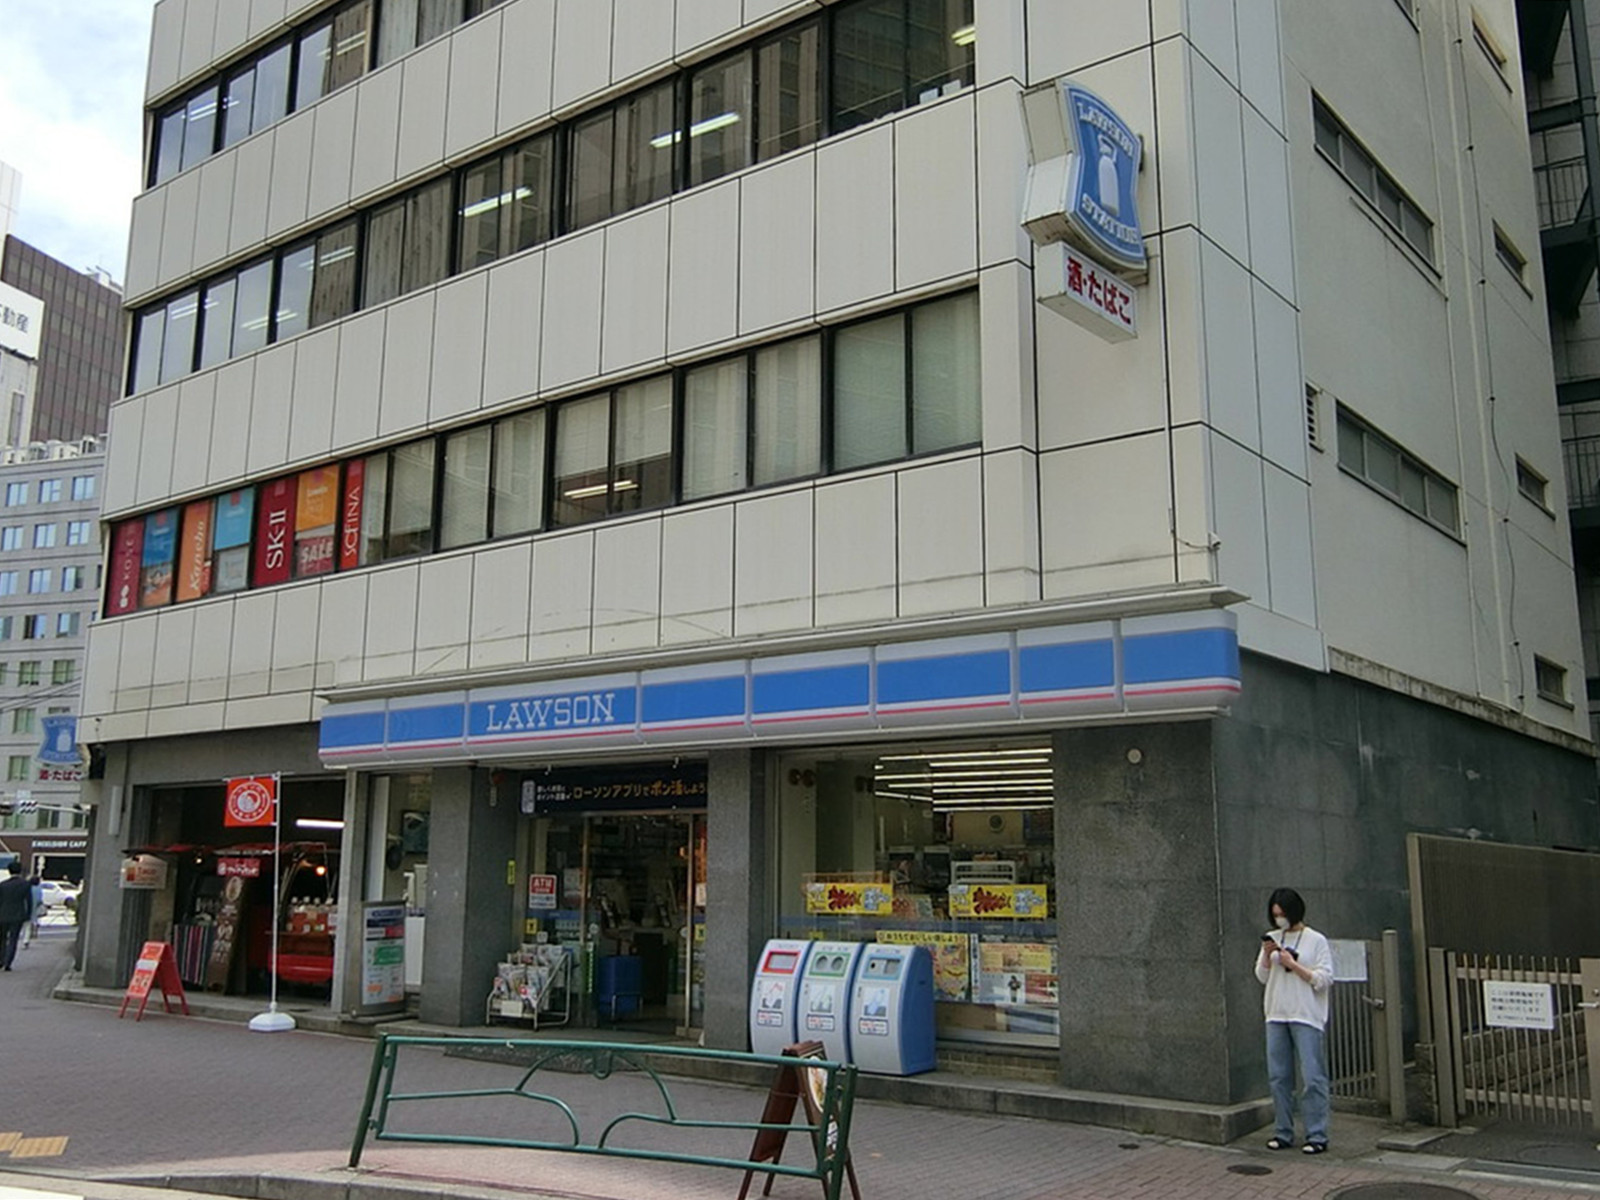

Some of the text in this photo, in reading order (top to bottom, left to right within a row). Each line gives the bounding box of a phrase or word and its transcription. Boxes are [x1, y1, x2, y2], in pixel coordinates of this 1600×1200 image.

[0, 304, 29, 334] 動産
[266, 508, 287, 569] SK-II
[344, 486, 362, 557] SOFINA
[189, 520, 205, 590] Kanebo
[300, 541, 333, 564] SALE
[487, 693, 616, 732] LAWSON
